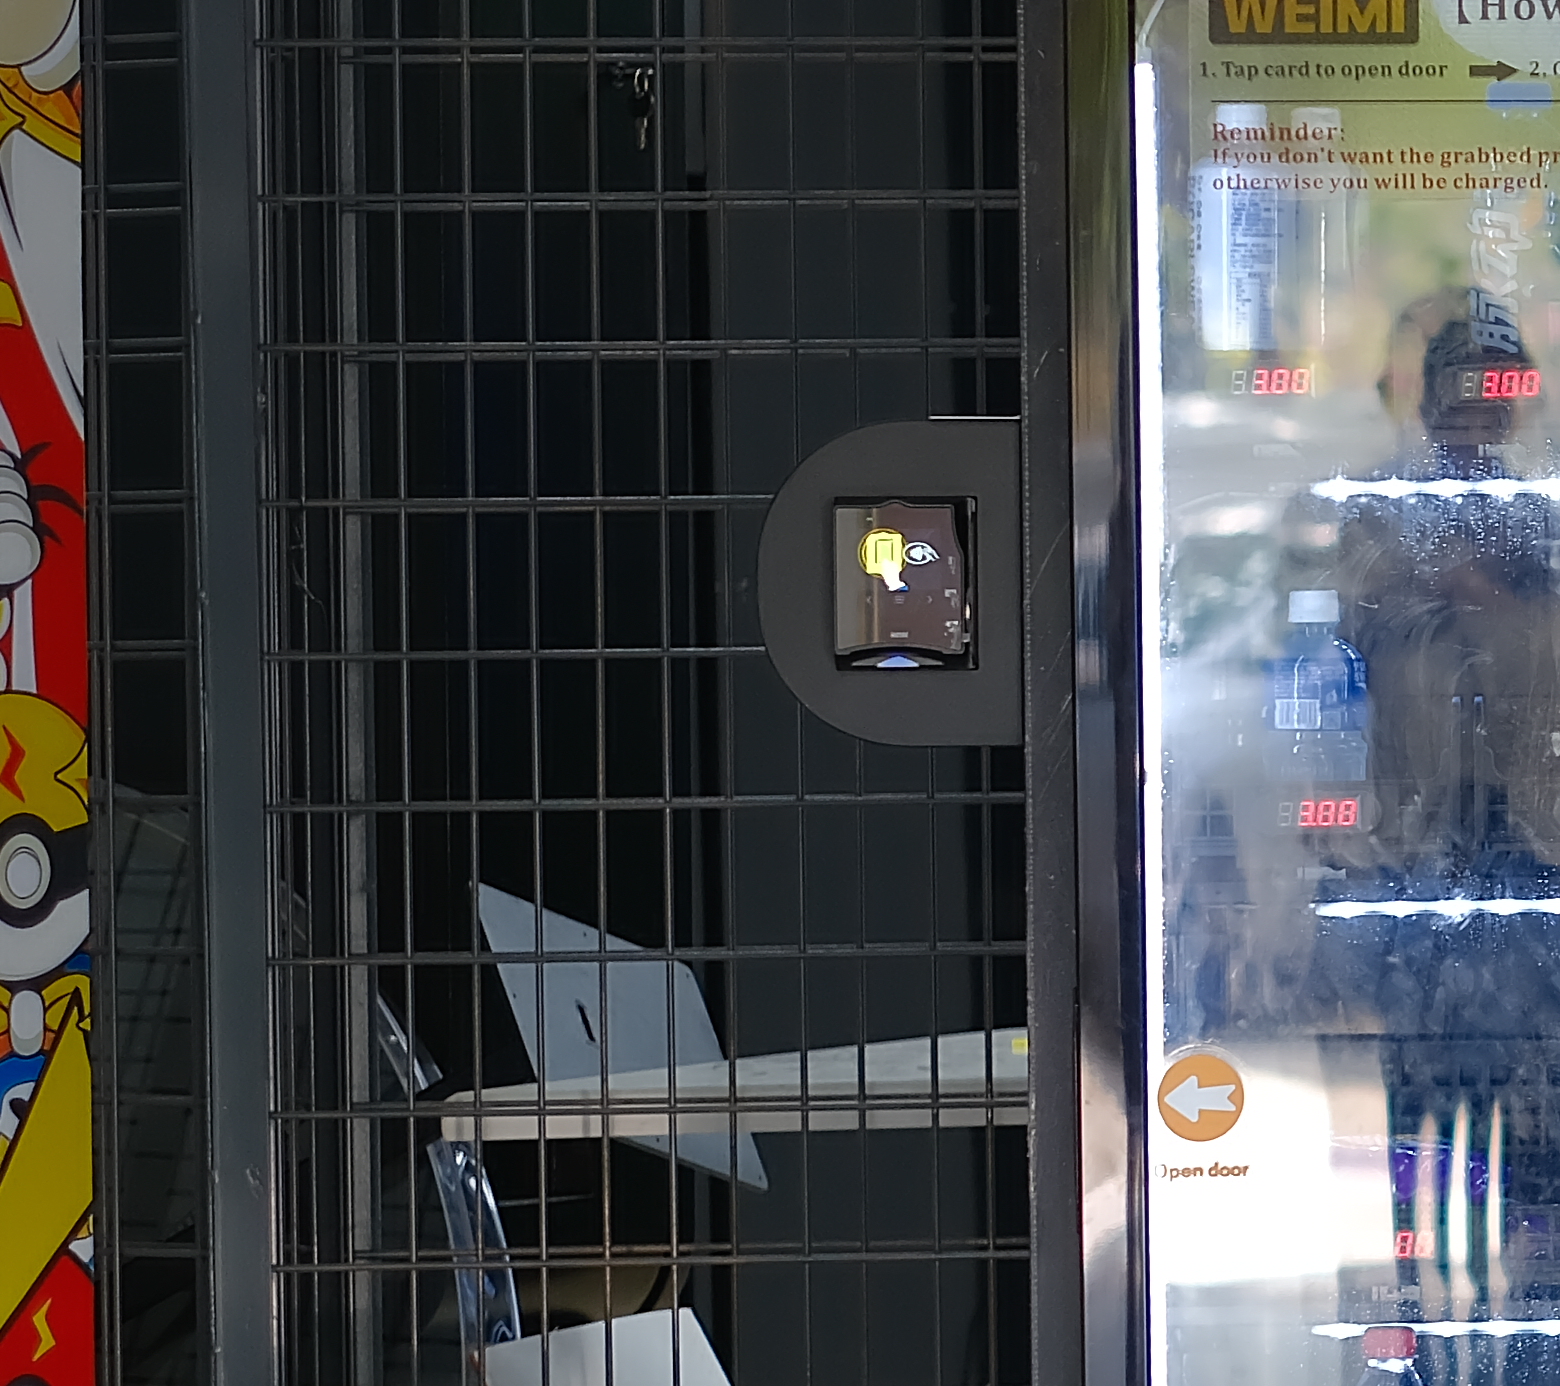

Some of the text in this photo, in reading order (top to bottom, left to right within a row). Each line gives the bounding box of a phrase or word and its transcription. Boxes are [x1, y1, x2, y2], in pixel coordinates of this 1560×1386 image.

[1199, 59, 1449, 83] 1. Tap card to open door
[1529, 60, 1547, 79] 2.
[1211, 118, 1346, 147] Reminder:
[1482, 369, 1541, 398] 3.00
[1209, 1162, 1250, 1178] door
